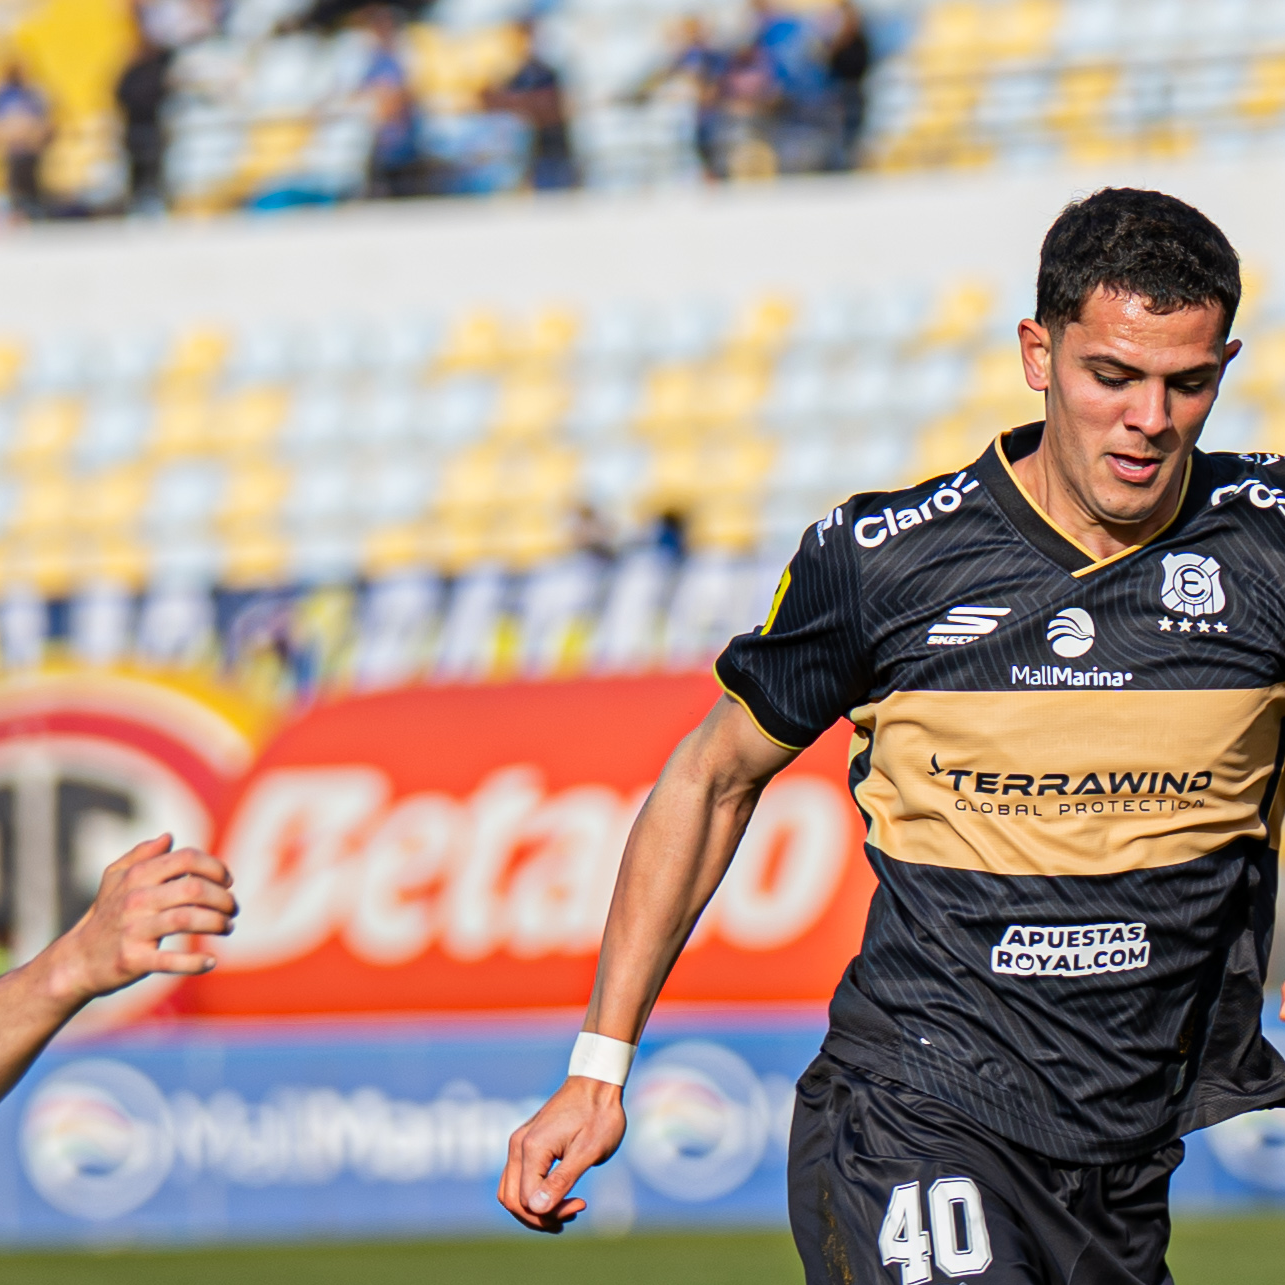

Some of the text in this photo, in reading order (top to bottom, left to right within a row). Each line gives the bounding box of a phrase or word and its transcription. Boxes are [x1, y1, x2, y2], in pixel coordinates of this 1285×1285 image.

[1011, 666, 1126, 687] MallMarina
[945, 769, 1213, 796] TERRAWIND
[955, 799, 1205, 817] GLOBAL PROTECTION
[217, 765, 855, 970] Betao
[1007, 926, 1142, 949] APUESTAS
[997, 946, 1147, 971] ROYAL.COM
